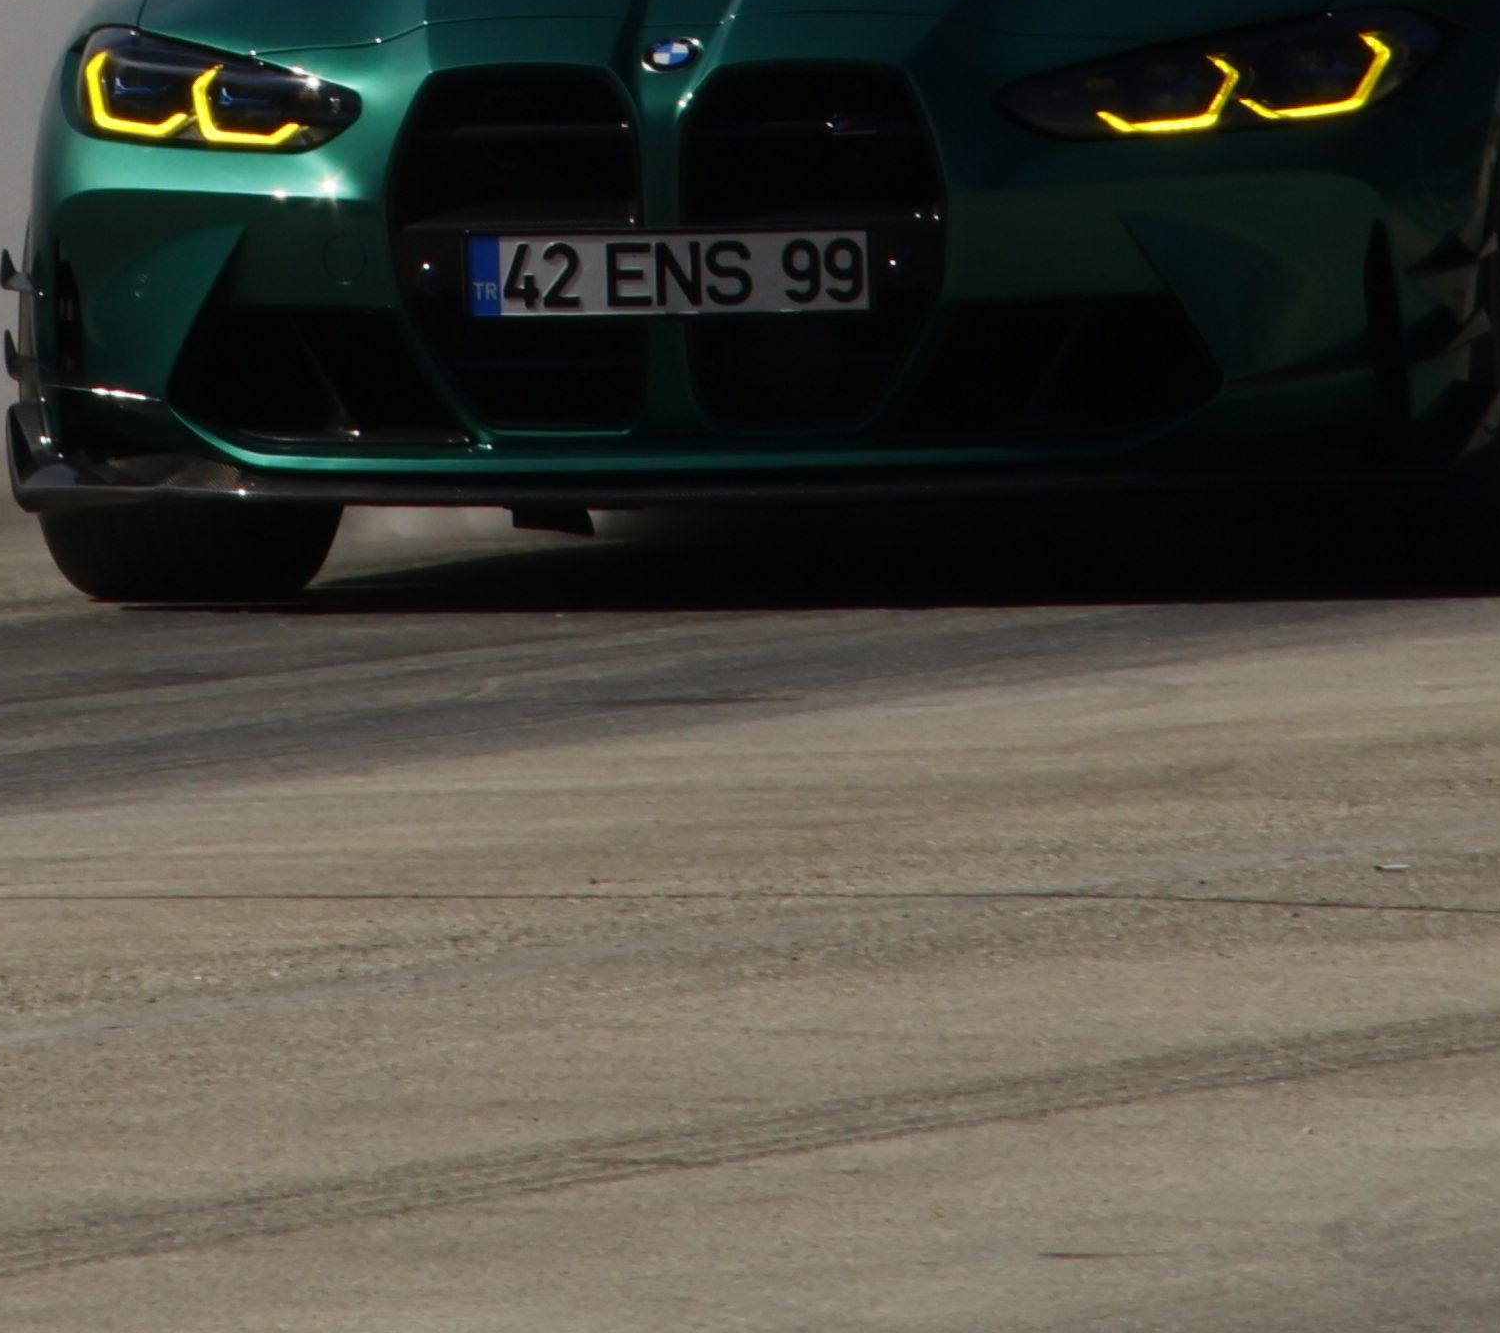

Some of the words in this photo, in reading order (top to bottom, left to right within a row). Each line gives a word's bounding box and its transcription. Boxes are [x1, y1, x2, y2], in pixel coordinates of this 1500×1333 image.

[473, 282, 497, 301] TR
[503, 242, 581, 309] 42
[605, 239, 753, 307] ENS
[781, 237, 864, 304] 99
